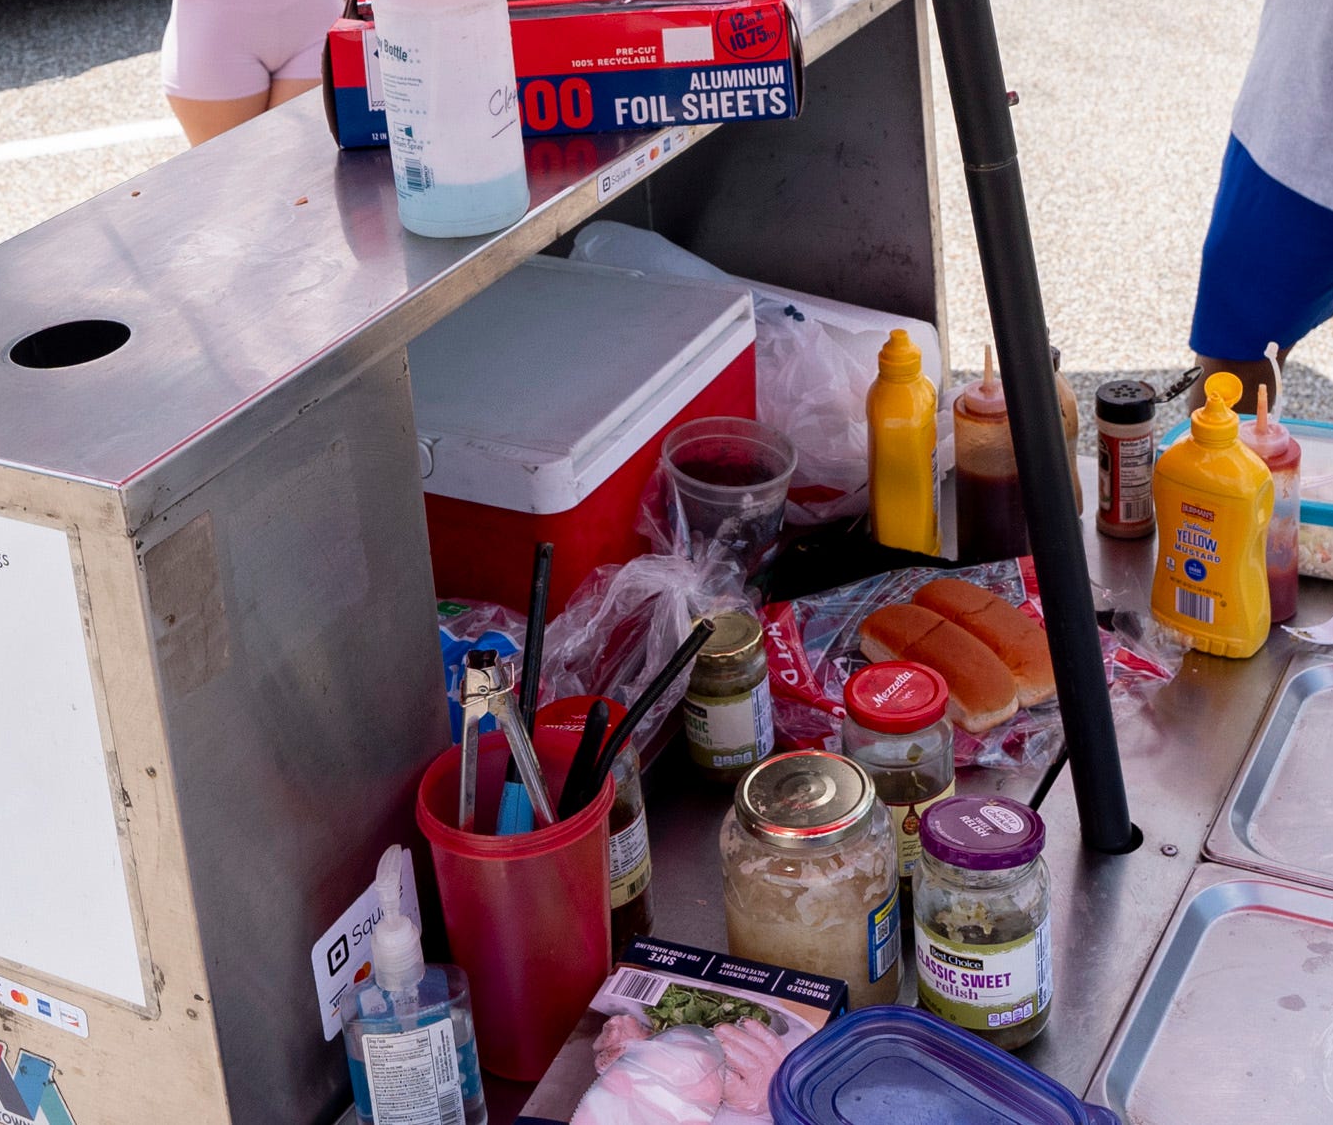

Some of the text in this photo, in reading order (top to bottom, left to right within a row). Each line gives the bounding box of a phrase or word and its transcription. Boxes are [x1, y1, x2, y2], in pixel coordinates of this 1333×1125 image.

[383, 38, 408, 62] Bottle
[616, 46, 657, 56] PRE-CUT
[571, 55, 657, 68] 100% RECYCLABLE
[689, 66, 785, 91] ALUMINUM
[615, 87, 788, 125] FOIL SHEETS
[1176, 528, 1218, 553] YELLOW
[1174, 543, 1221, 564] MUSTARD
[767, 621, 794, 663] HOT
[871, 671, 914, 707] Mezzetta
[959, 815, 990, 837] RELISH
[647, 951, 677, 966] SAFE
[668, 949, 686, 959] FOOD
[687, 953, 701, 963] FOR
[931, 946, 982, 969] Best Choice
[716, 968, 765, 984] HIGH-DENSITY
[721, 961, 770, 977] POLYETHYLENE
[917, 944, 1012, 989] CLASSIC SWEET
[786, 984, 830, 1001] EMBOSSED
[795, 977, 831, 993] SURFACE
[935, 978, 979, 1001] relish
